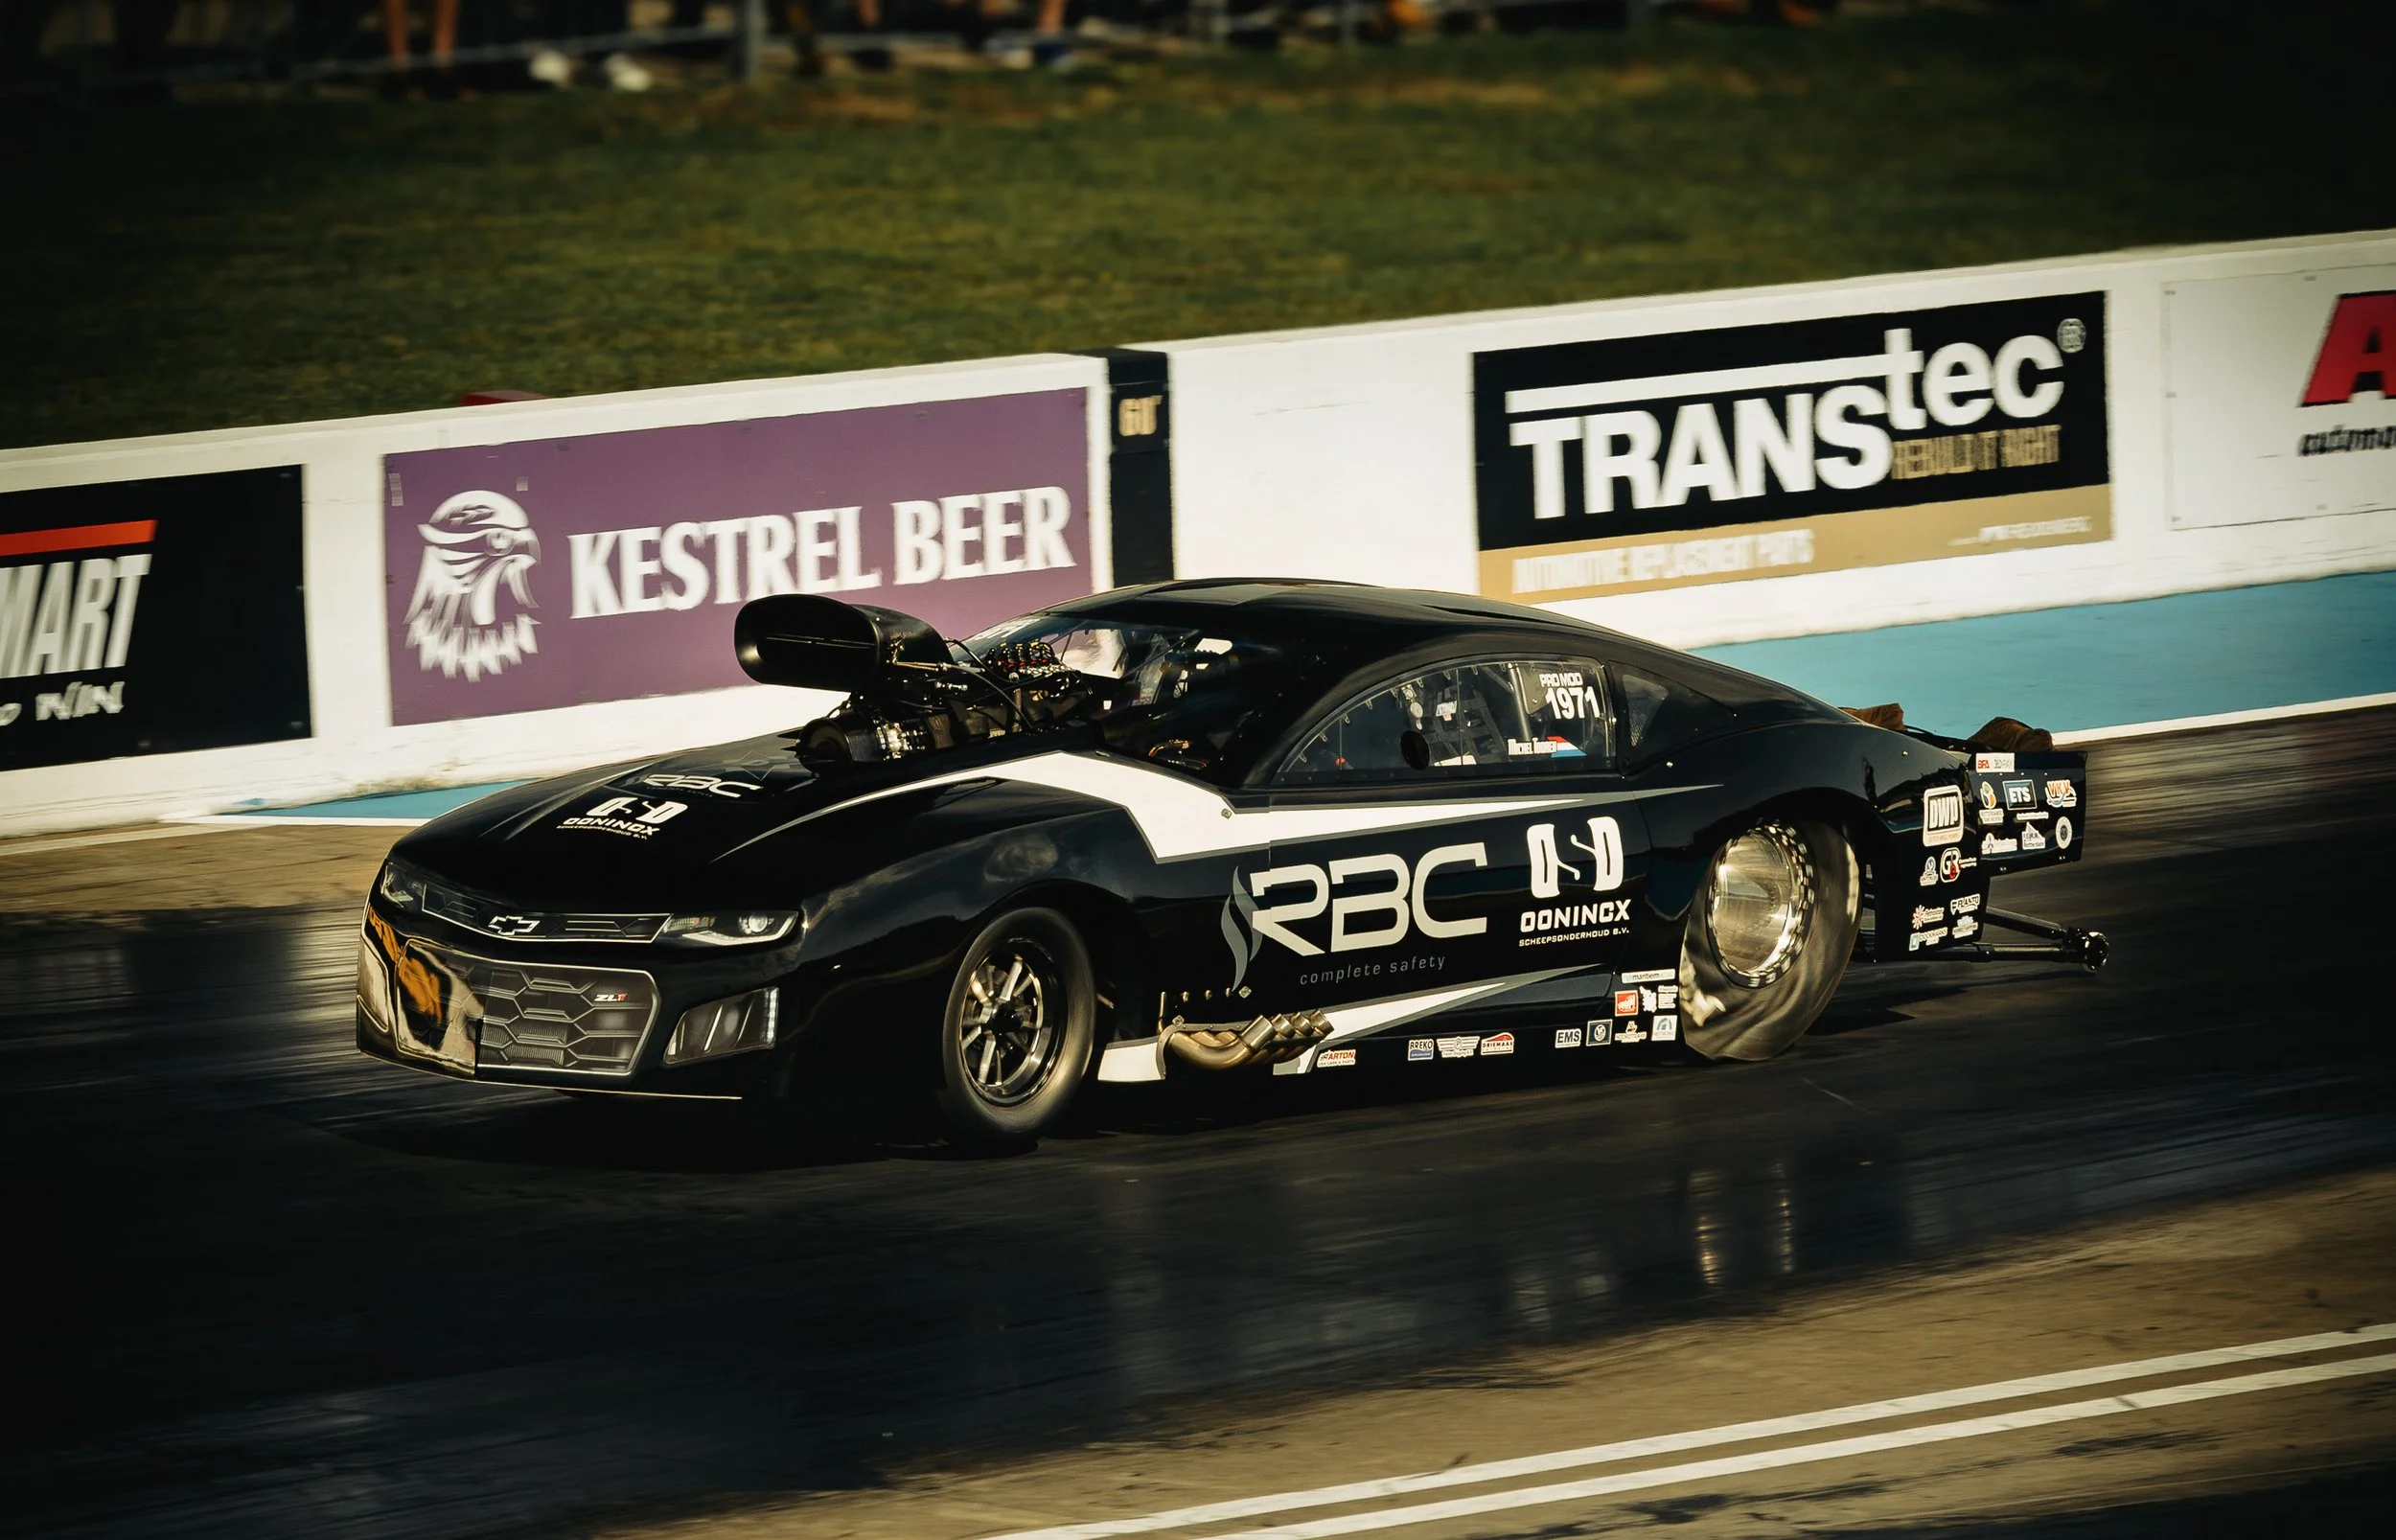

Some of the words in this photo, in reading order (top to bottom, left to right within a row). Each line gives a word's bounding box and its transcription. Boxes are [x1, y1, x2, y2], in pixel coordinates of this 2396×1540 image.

[566, 506, 882, 619] KESTREL
[891, 486, 1077, 586] BEER
[1539, 673, 1560, 687] PRO
[1558, 672, 1583, 686] MOD
[1545, 686, 1601, 719] 1971
[2008, 787, 2031, 803] ETS
[1928, 795, 1959, 829] DWP
[1250, 841, 1488, 956] RBC
[1520, 899, 1632, 932] OONINCX
[1518, 929, 1610, 947] SCHEEPSONDERHOUD
[1612, 927, 1630, 935] B.V.
[1300, 964, 1381, 984] complete
[1389, 955, 1445, 974] safety
[1556, 1030, 1580, 1044] EMS
